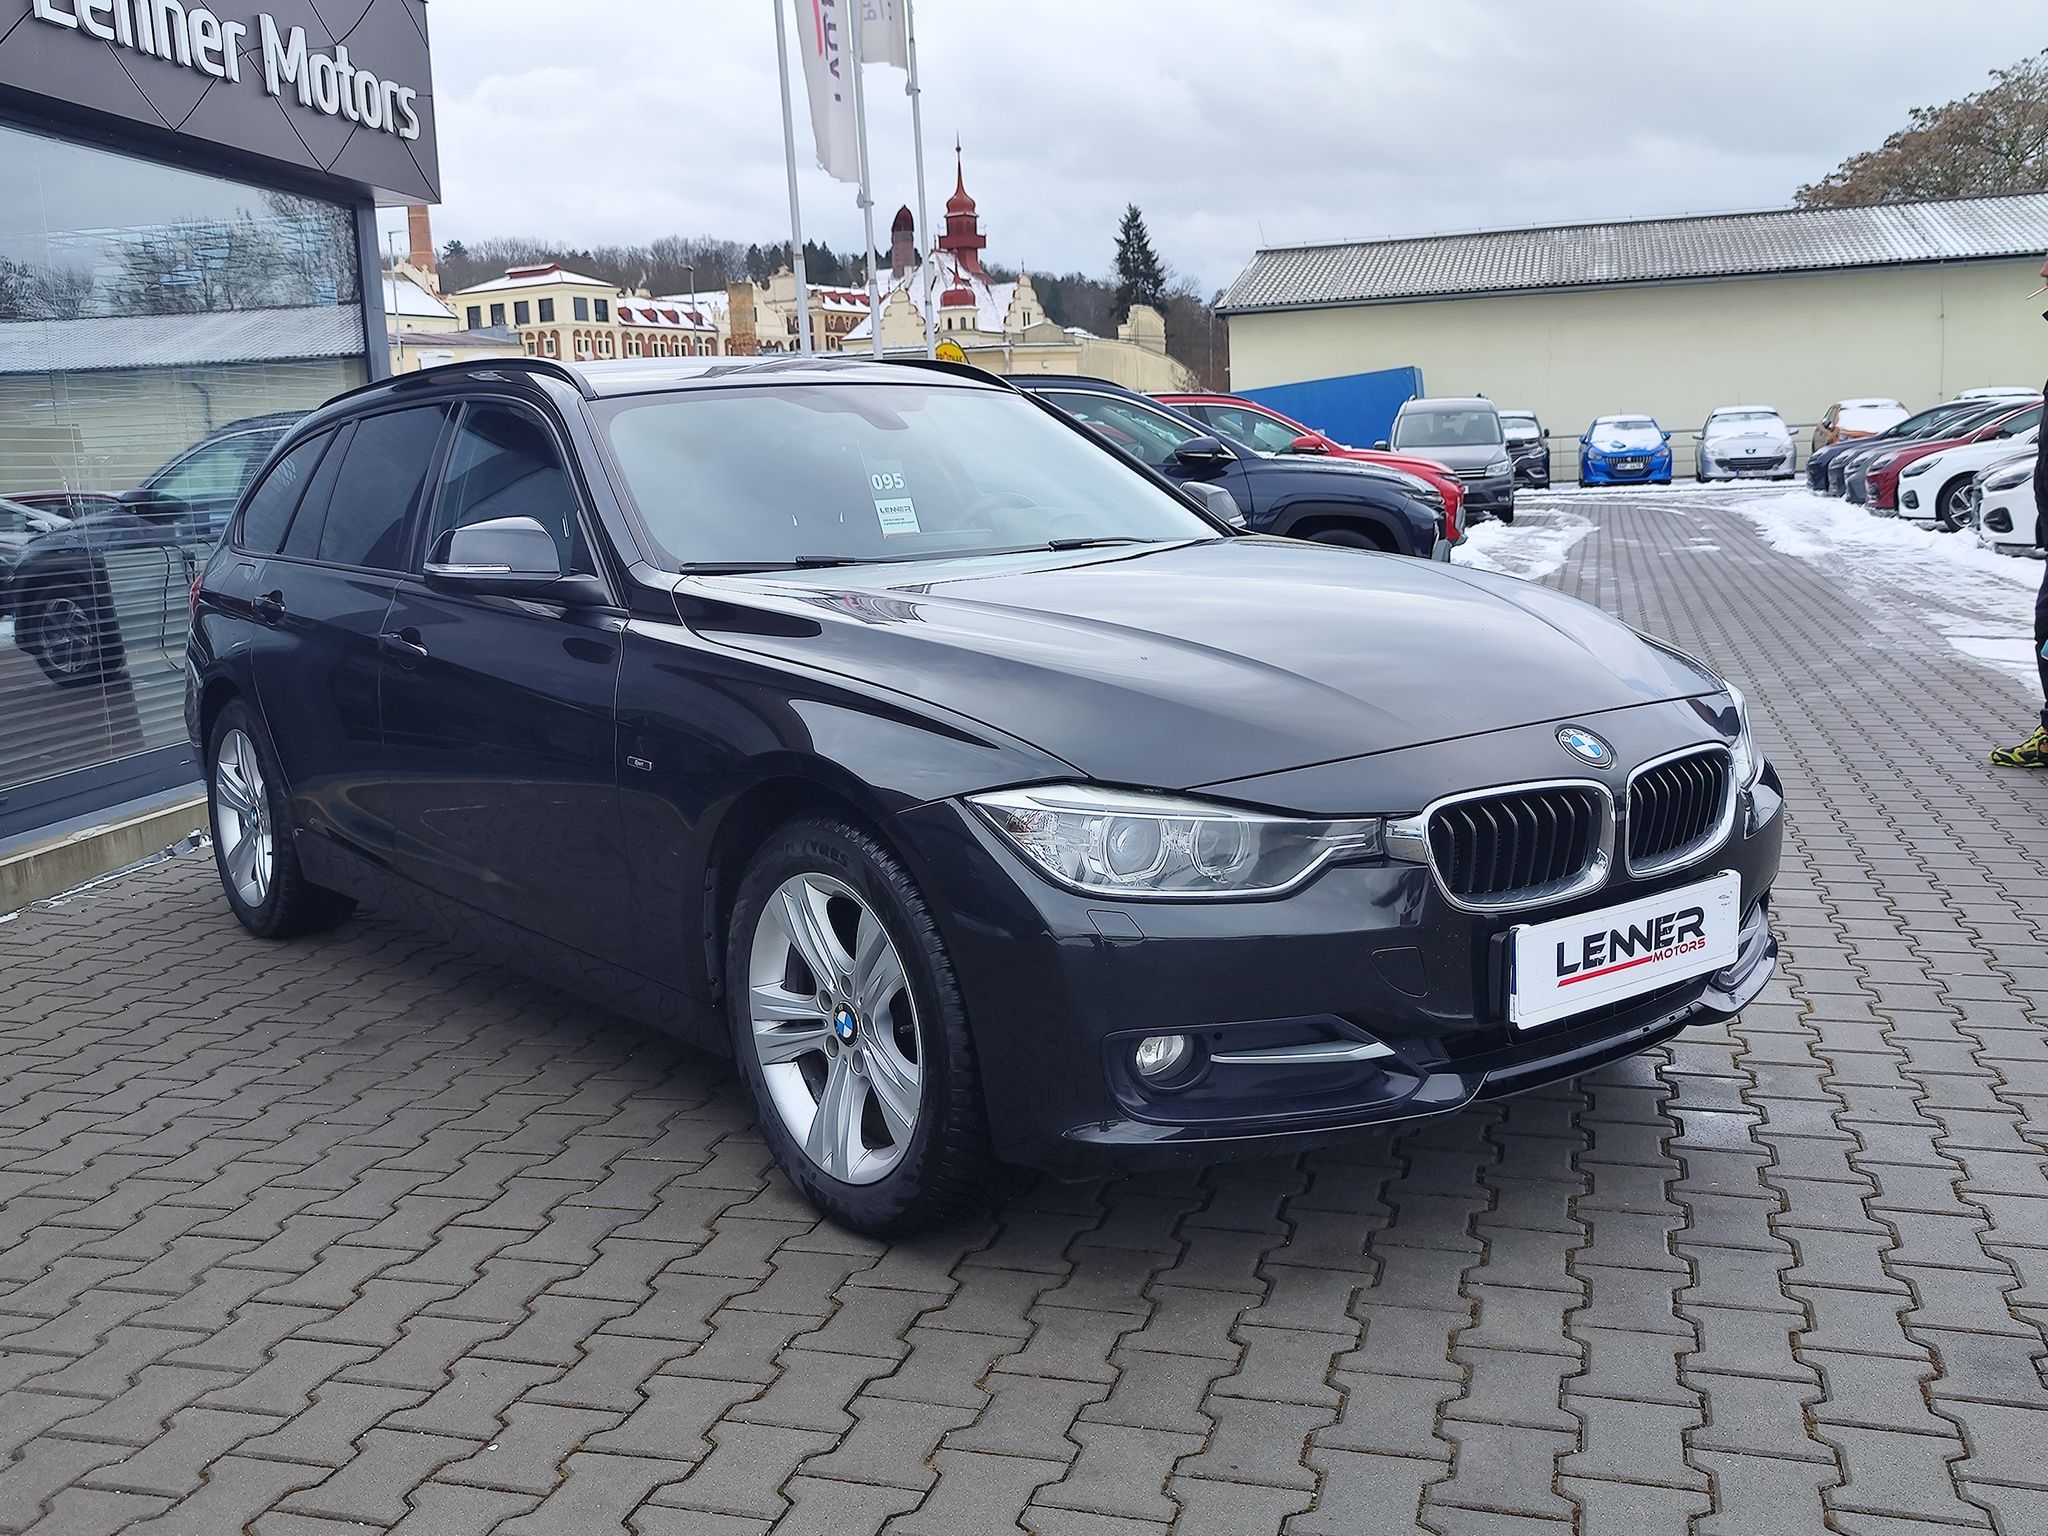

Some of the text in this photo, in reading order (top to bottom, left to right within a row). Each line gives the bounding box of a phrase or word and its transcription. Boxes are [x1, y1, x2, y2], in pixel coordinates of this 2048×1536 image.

[258, 13, 420, 140] Motors
[871, 472, 905, 490] 095
[880, 505, 912, 514] LENNER
[1556, 906, 1705, 977] LENNER
[1652, 937, 1706, 963] MOTORS
